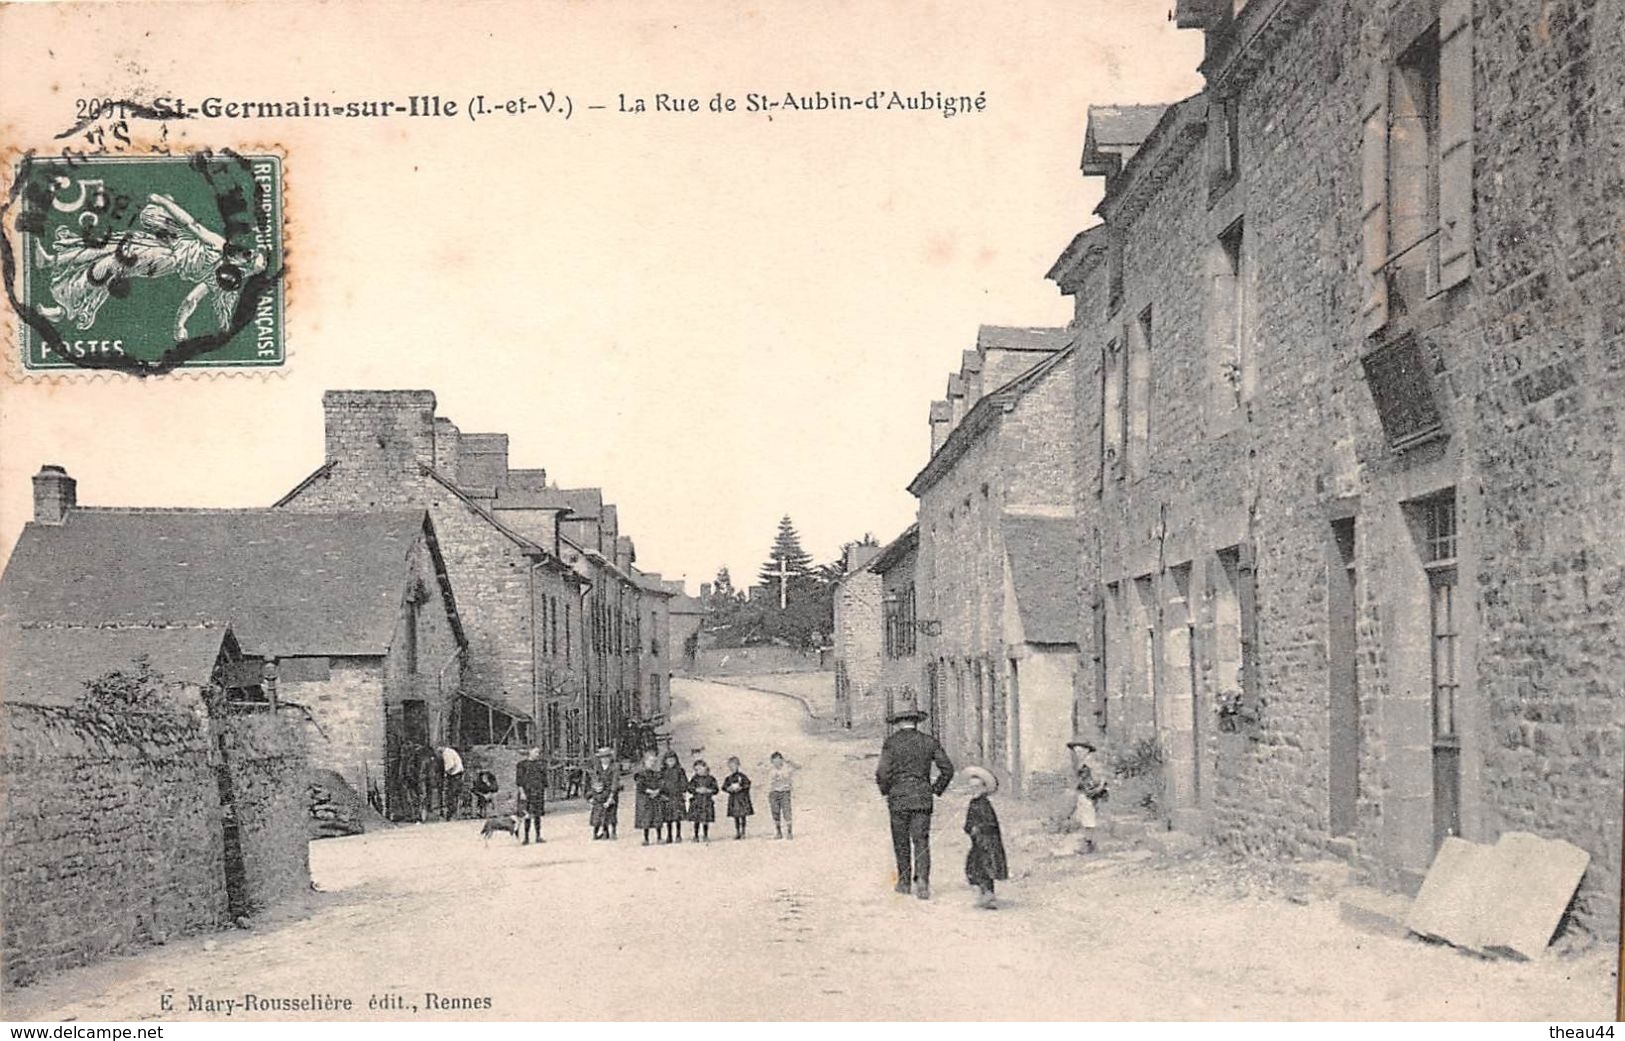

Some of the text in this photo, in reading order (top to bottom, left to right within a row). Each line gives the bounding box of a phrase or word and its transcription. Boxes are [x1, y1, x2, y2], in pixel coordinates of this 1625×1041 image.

[153, 96, 458, 119] St-Germain-sur-Ille
[468, 91, 573, 121] (I.-et-V.)
[618, 93, 646, 113] La
[655, 93, 700, 112] Rue
[709, 93, 737, 113] de
[746, 91, 987, 118] St-Aubin-d'Aubigné
[188, 994, 353, 1017] Mary-Rousselière
[425, 992, 492, 1010] Rennes
